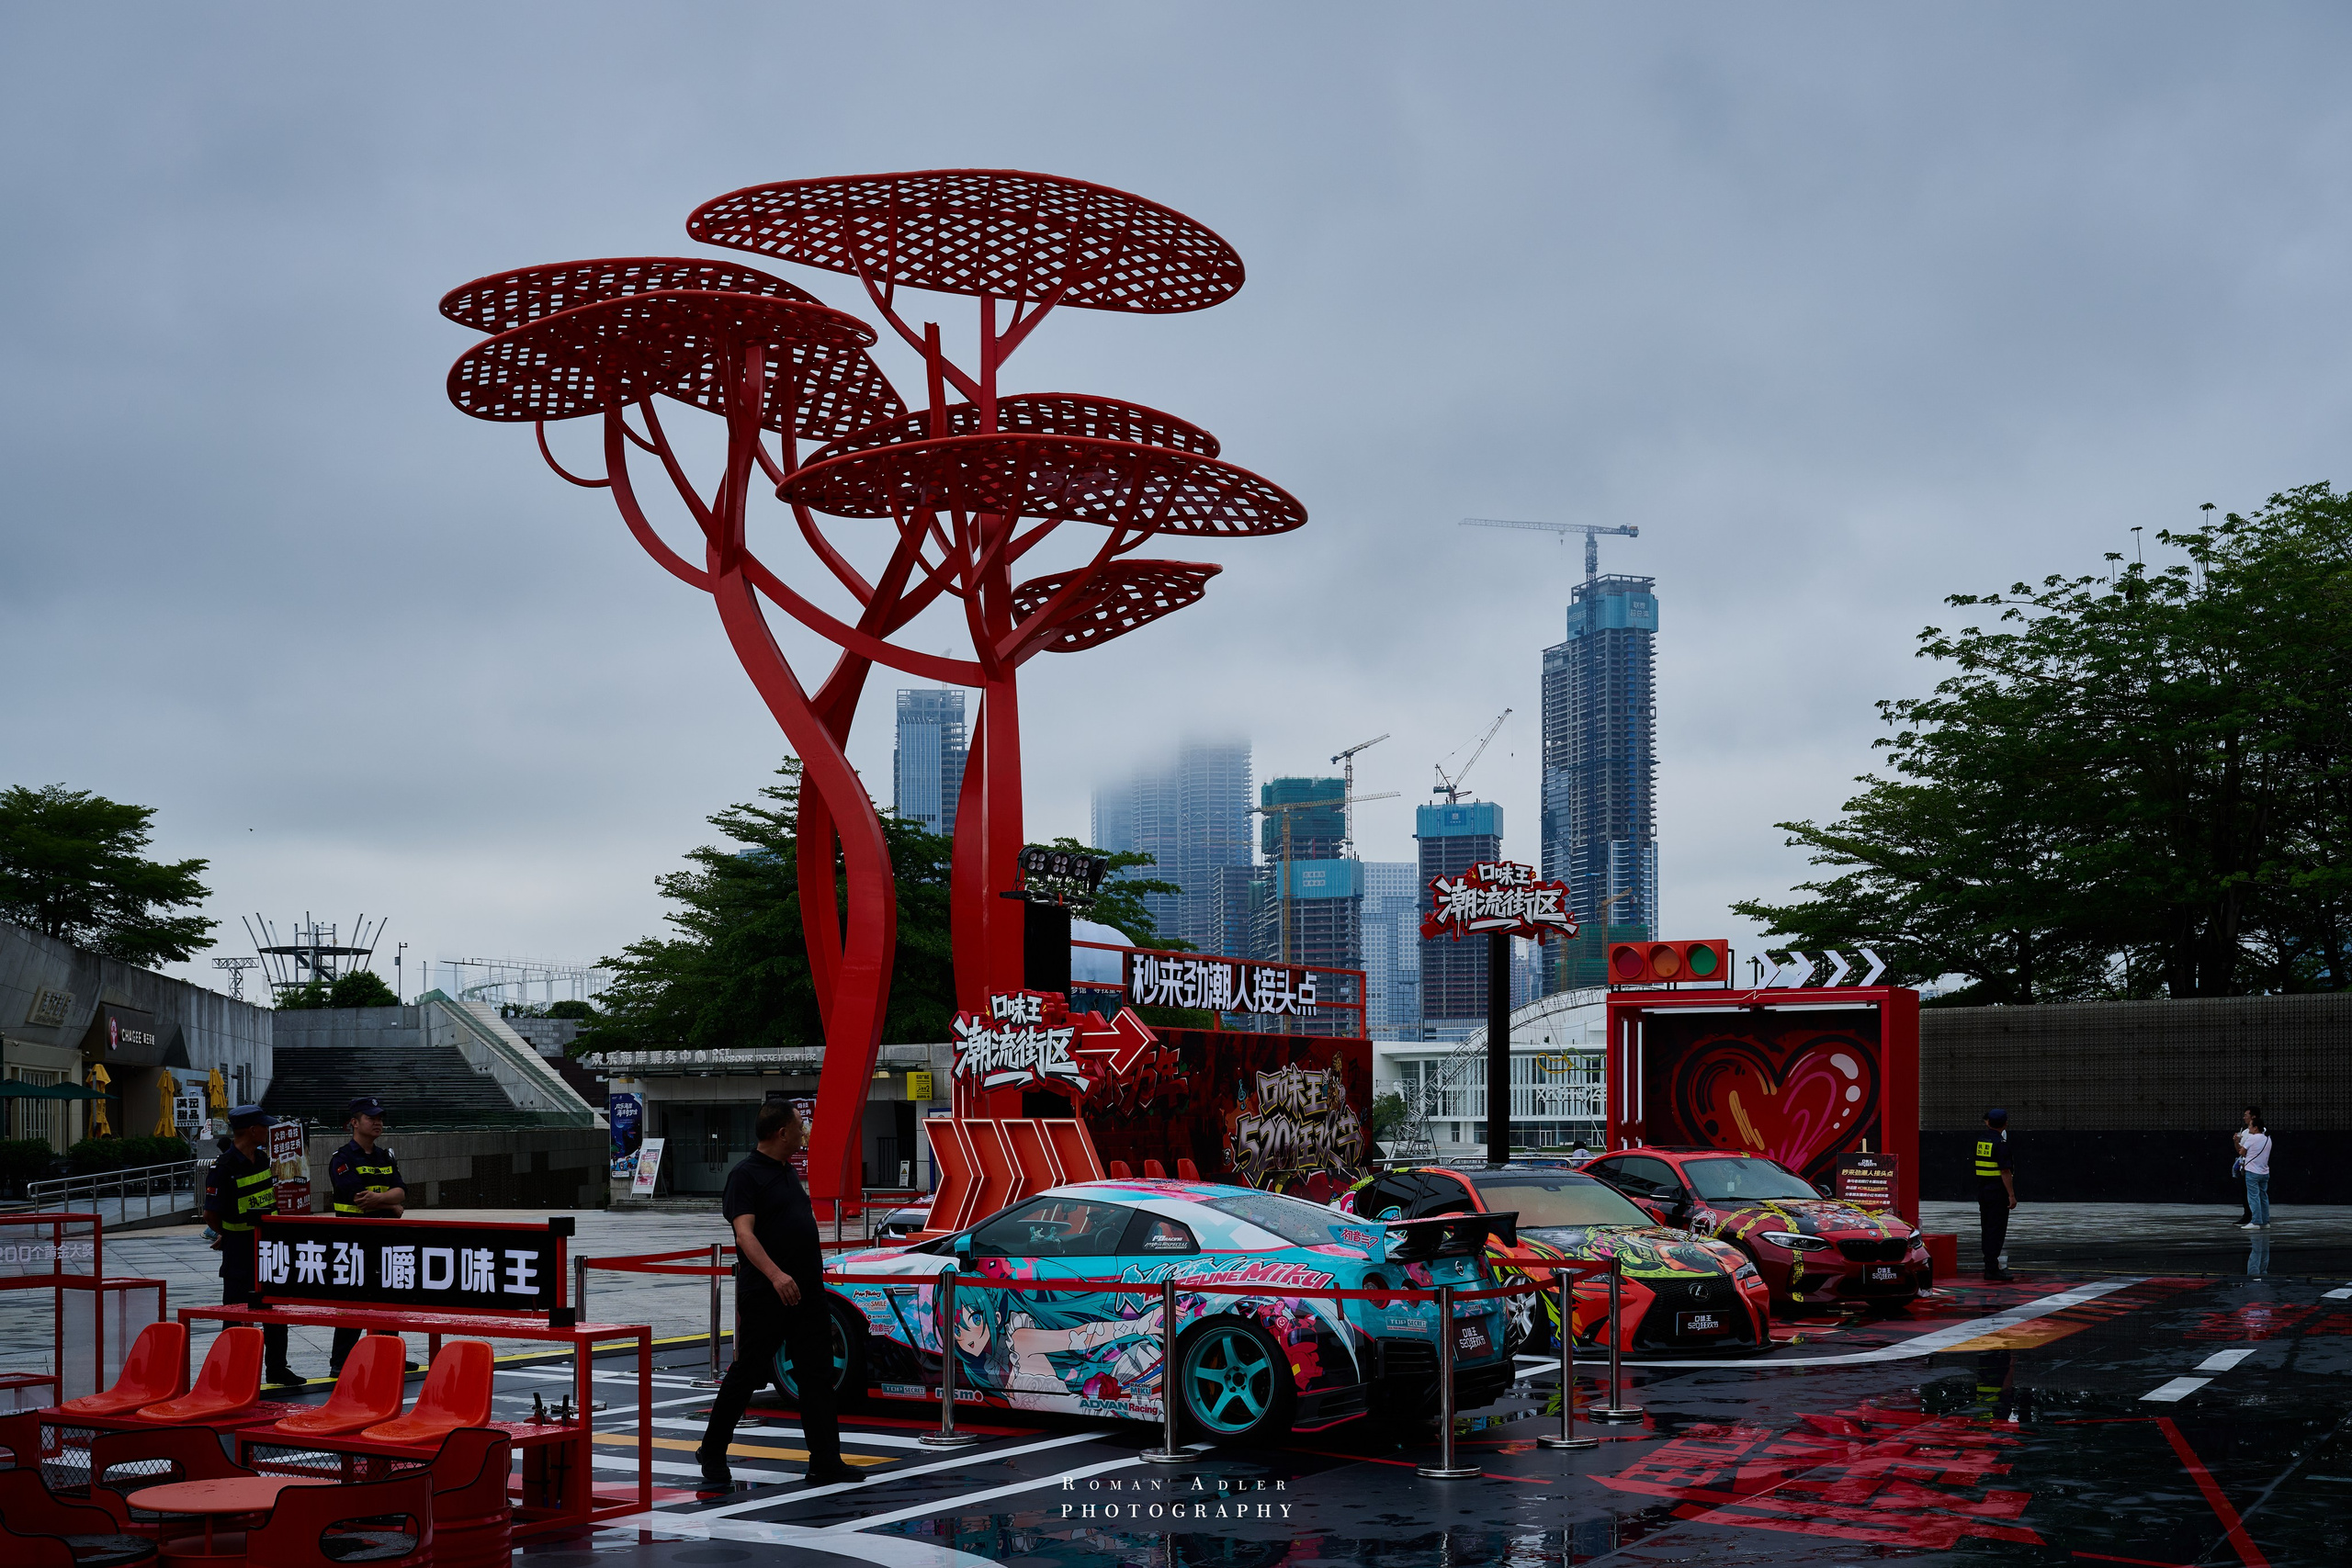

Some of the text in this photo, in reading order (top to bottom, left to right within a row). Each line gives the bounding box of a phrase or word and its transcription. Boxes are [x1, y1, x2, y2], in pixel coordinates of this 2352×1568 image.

[1477, 863, 1532, 886] 口味王
[1435, 876, 1569, 928] 潮流街区
[1133, 954, 1317, 1017] 秒来劲潮人接头点
[991, 992, 1043, 1024] 口味王
[121, 1028, 141, 1044] CHAGEE
[592, 1049, 707, 1066] 欢乐海岸票务中心
[755, 1054, 783, 1062] TICKET
[784, 1053, 817, 1062] CENTER
[953, 1015, 1080, 1082] 潮流街区
[1258, 1066, 1328, 1118] 口味王
[176, 1110, 199, 1119] 甜品
[1237, 1106, 1364, 1172] 520狂欢节
[1340, 1228, 1379, 1249] 初音ミク
[258, 1240, 540, 1295] 秒来劲 嚼口味王
[904, 1386, 924, 1394] SECRET
[936, 1388, 984, 1403] nsmo
[1130, 1387, 1151, 1395] MIKU
[1080, 1399, 1158, 1416] ADVAN Racing
